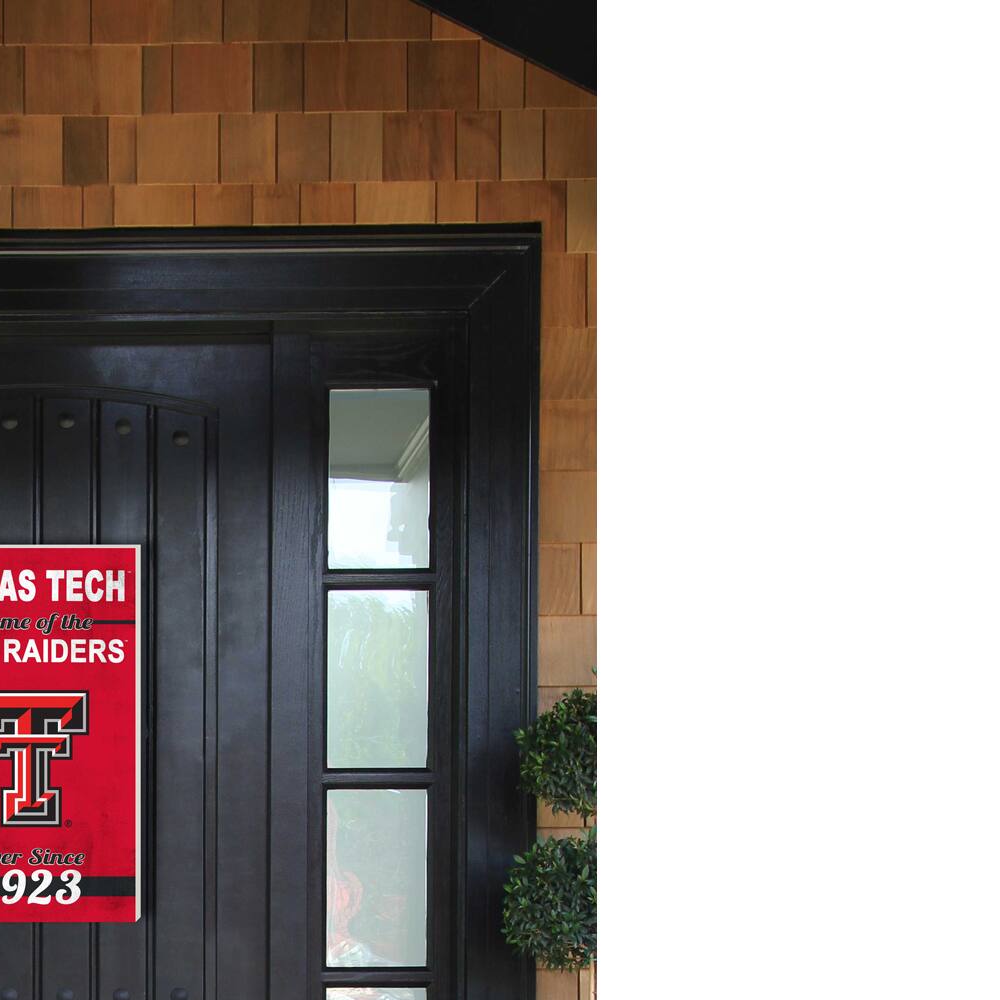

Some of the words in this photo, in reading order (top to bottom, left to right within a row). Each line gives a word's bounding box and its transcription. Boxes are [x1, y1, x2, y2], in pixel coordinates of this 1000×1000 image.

[45, 569, 125, 602] TECH
[36, 612, 60, 635] of
[61, 613, 93, 631] the
[3, 638, 125, 664] RAIDERS
[28, 848, 86, 866] Since
